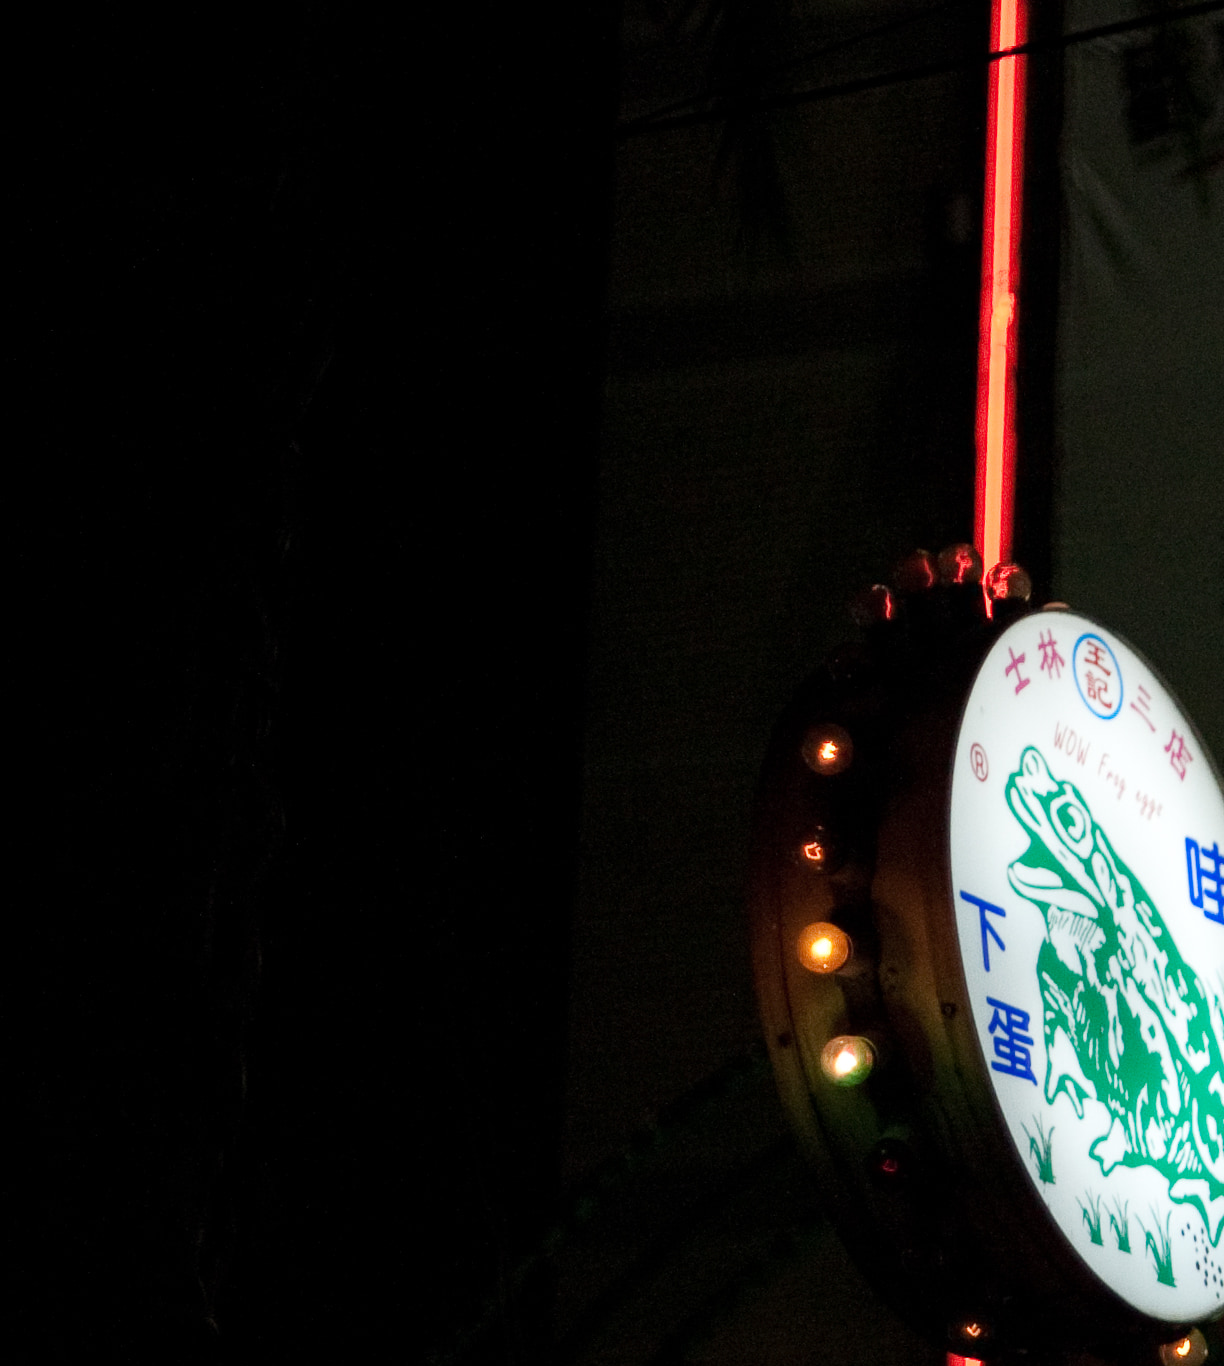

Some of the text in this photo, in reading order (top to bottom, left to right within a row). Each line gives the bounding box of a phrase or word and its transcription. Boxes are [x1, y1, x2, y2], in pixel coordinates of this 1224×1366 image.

[1005, 628, 1065, 695] 士林
[1084, 640, 1113, 709] 王記
[1130, 685, 1193, 782] 三店
[1054, 721, 1091, 766] WOW
[960, 889, 1038, 1087] 下蛋
